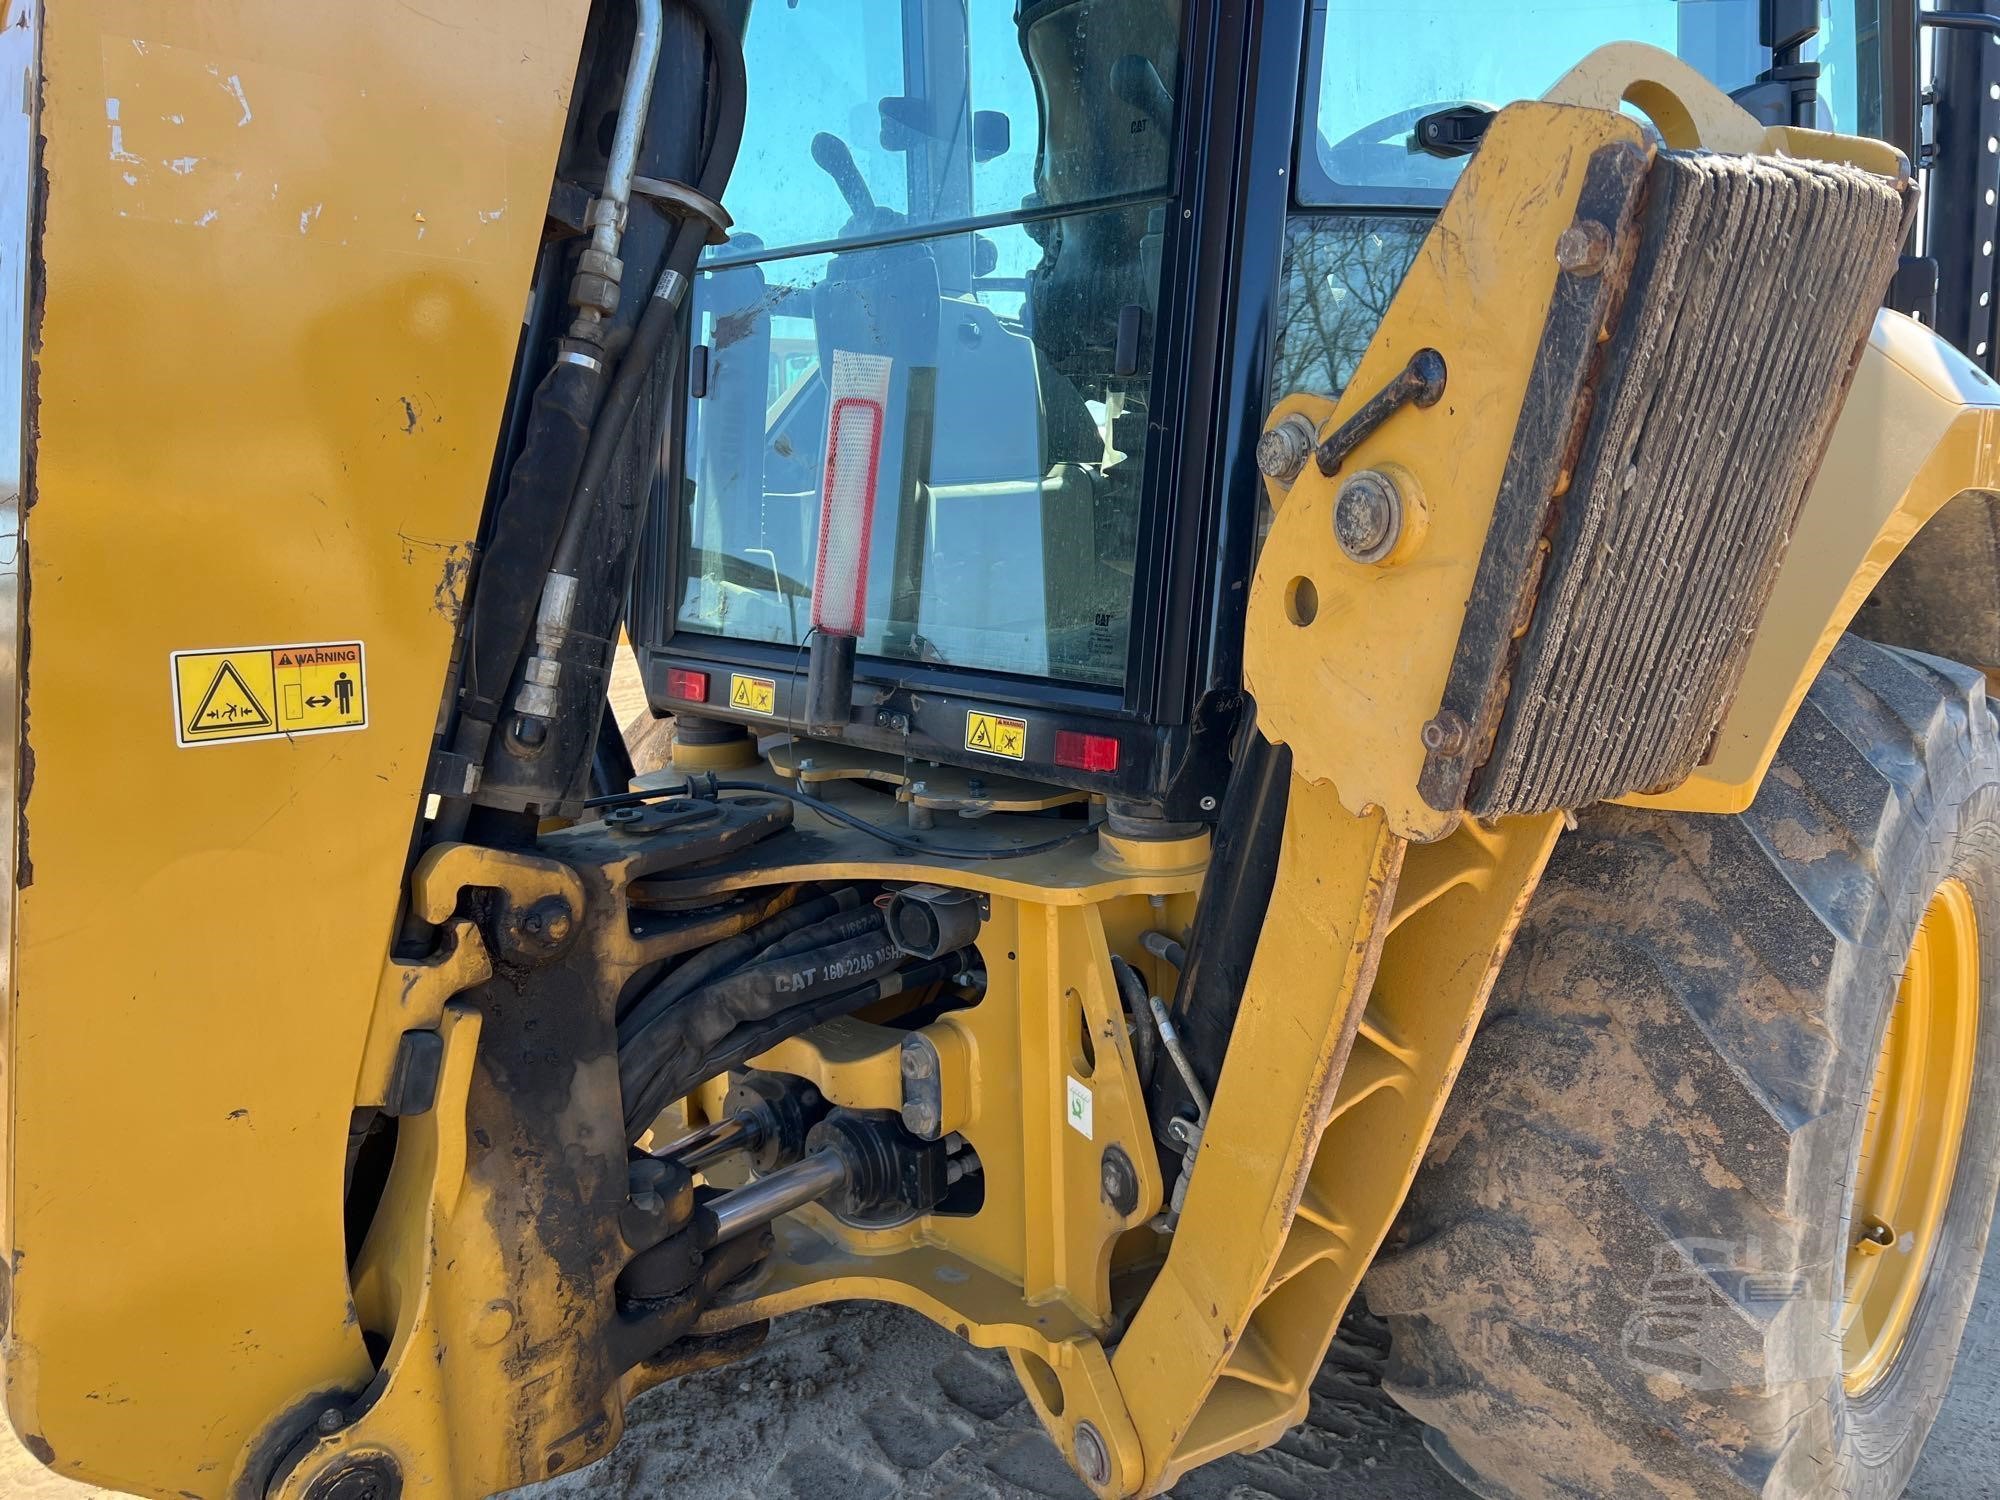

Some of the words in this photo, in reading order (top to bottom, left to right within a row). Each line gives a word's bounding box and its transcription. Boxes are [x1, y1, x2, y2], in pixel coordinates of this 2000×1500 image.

[1131, 119, 1147, 134] CAT
[1095, 613, 1110, 626] CAT
[295, 651, 356, 664] WARNING
[775, 967, 817, 993] CAT
[823, 953, 875, 981] 160-2246
